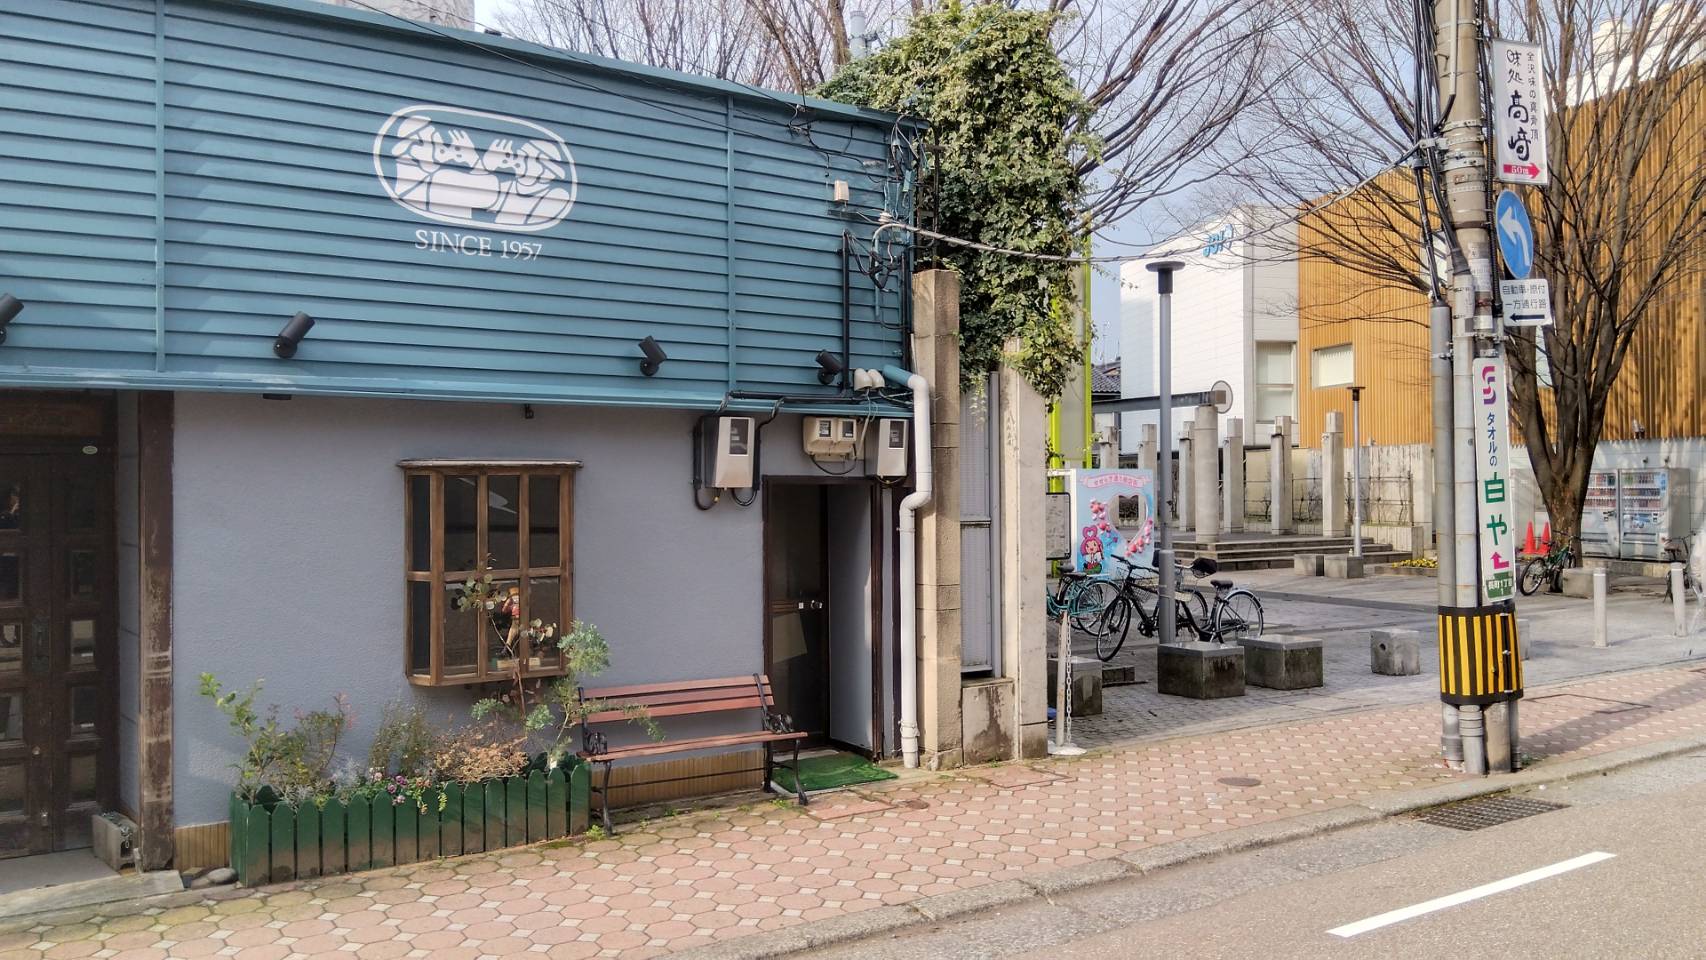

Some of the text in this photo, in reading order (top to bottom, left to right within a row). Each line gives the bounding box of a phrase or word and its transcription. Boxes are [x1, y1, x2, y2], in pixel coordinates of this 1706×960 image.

[415, 229, 542, 261] SINCE 1957
[1487, 412, 1498, 467] タオルの
[1484, 472, 1508, 546] 白や
